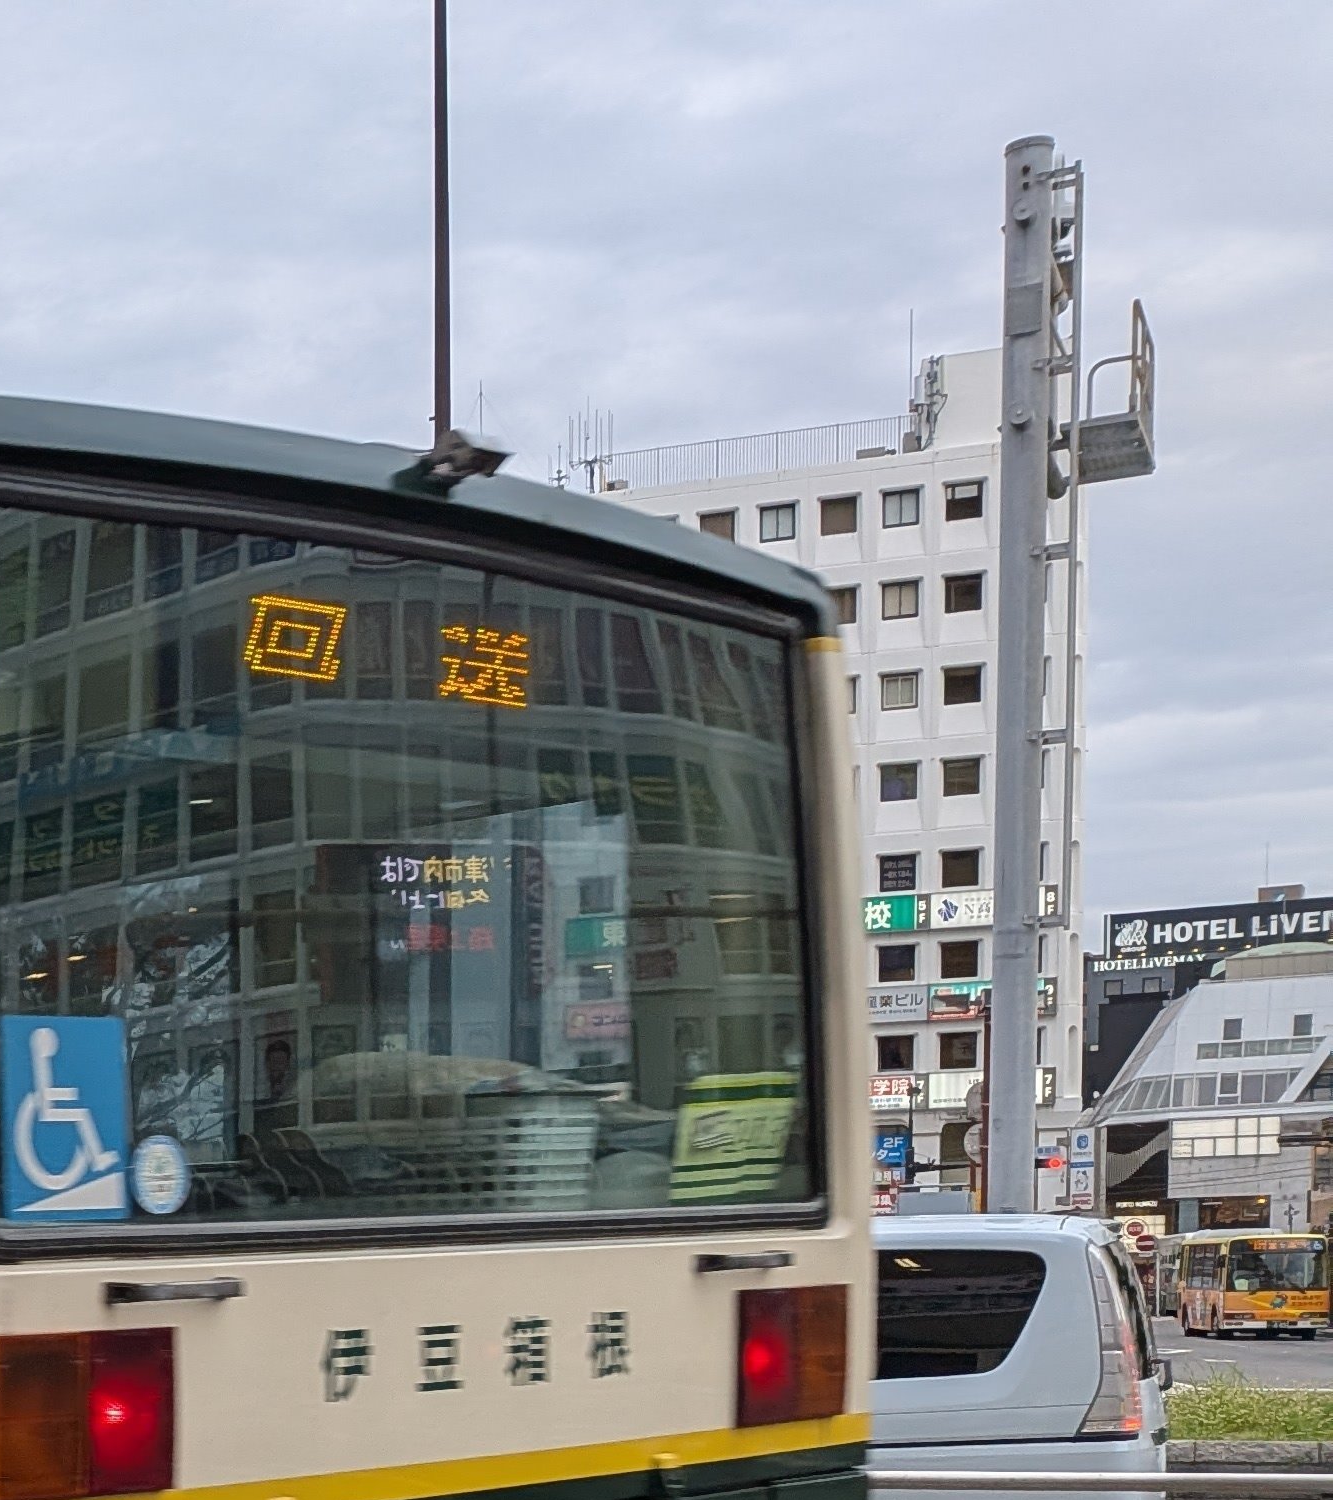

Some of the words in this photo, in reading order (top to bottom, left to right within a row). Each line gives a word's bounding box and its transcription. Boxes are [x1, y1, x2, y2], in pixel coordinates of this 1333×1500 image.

[244, 594, 530, 708] 回送
[865, 901, 891, 929] 校
[1153, 917, 1244, 945] HOTEL
[883, 1136, 904, 1148] 2F
[320, 1311, 631, 1403] 伊豆箱根
